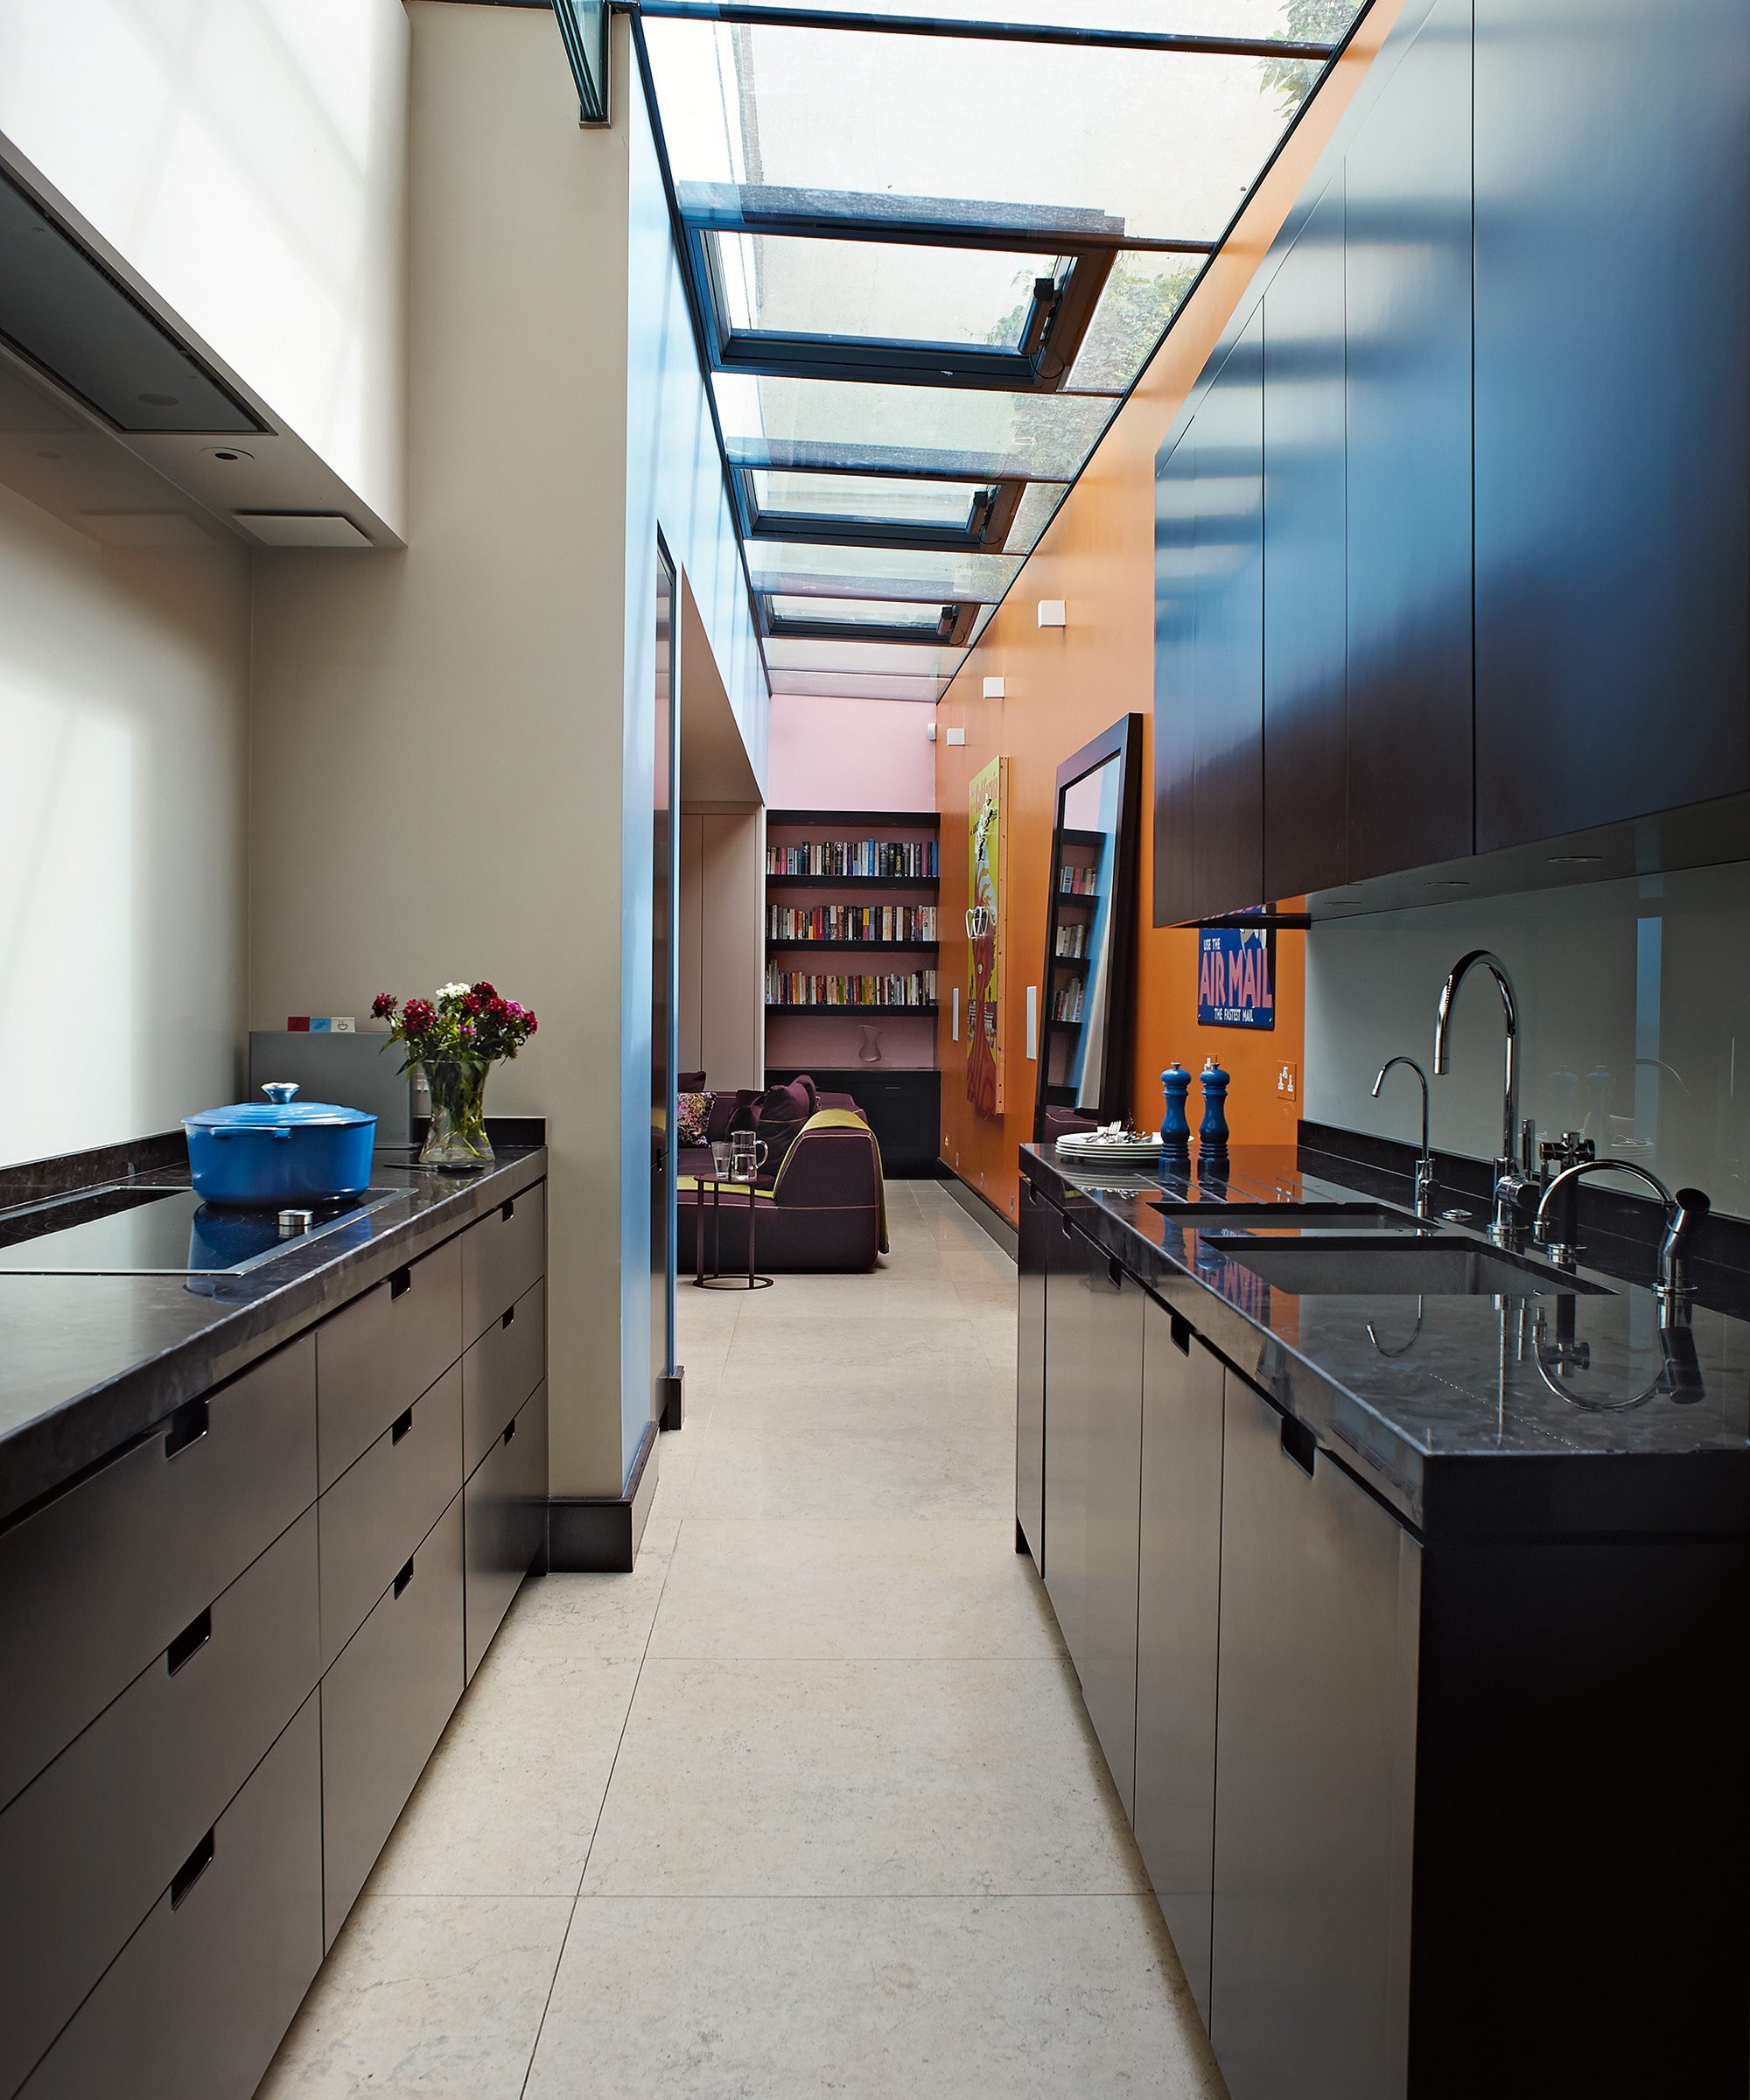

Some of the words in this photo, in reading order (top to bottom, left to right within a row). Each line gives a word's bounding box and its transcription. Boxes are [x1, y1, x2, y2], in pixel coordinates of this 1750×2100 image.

[1212, 937, 1221, 950] THE
[1199, 951, 1226, 1006] AIR
[1228, 948, 1272, 1008] MAIL
[1214, 1007, 1223, 1020] THE
[1224, 1008, 1242, 1022] FASTEST
[1242, 1009, 1254, 1023] MAIL
